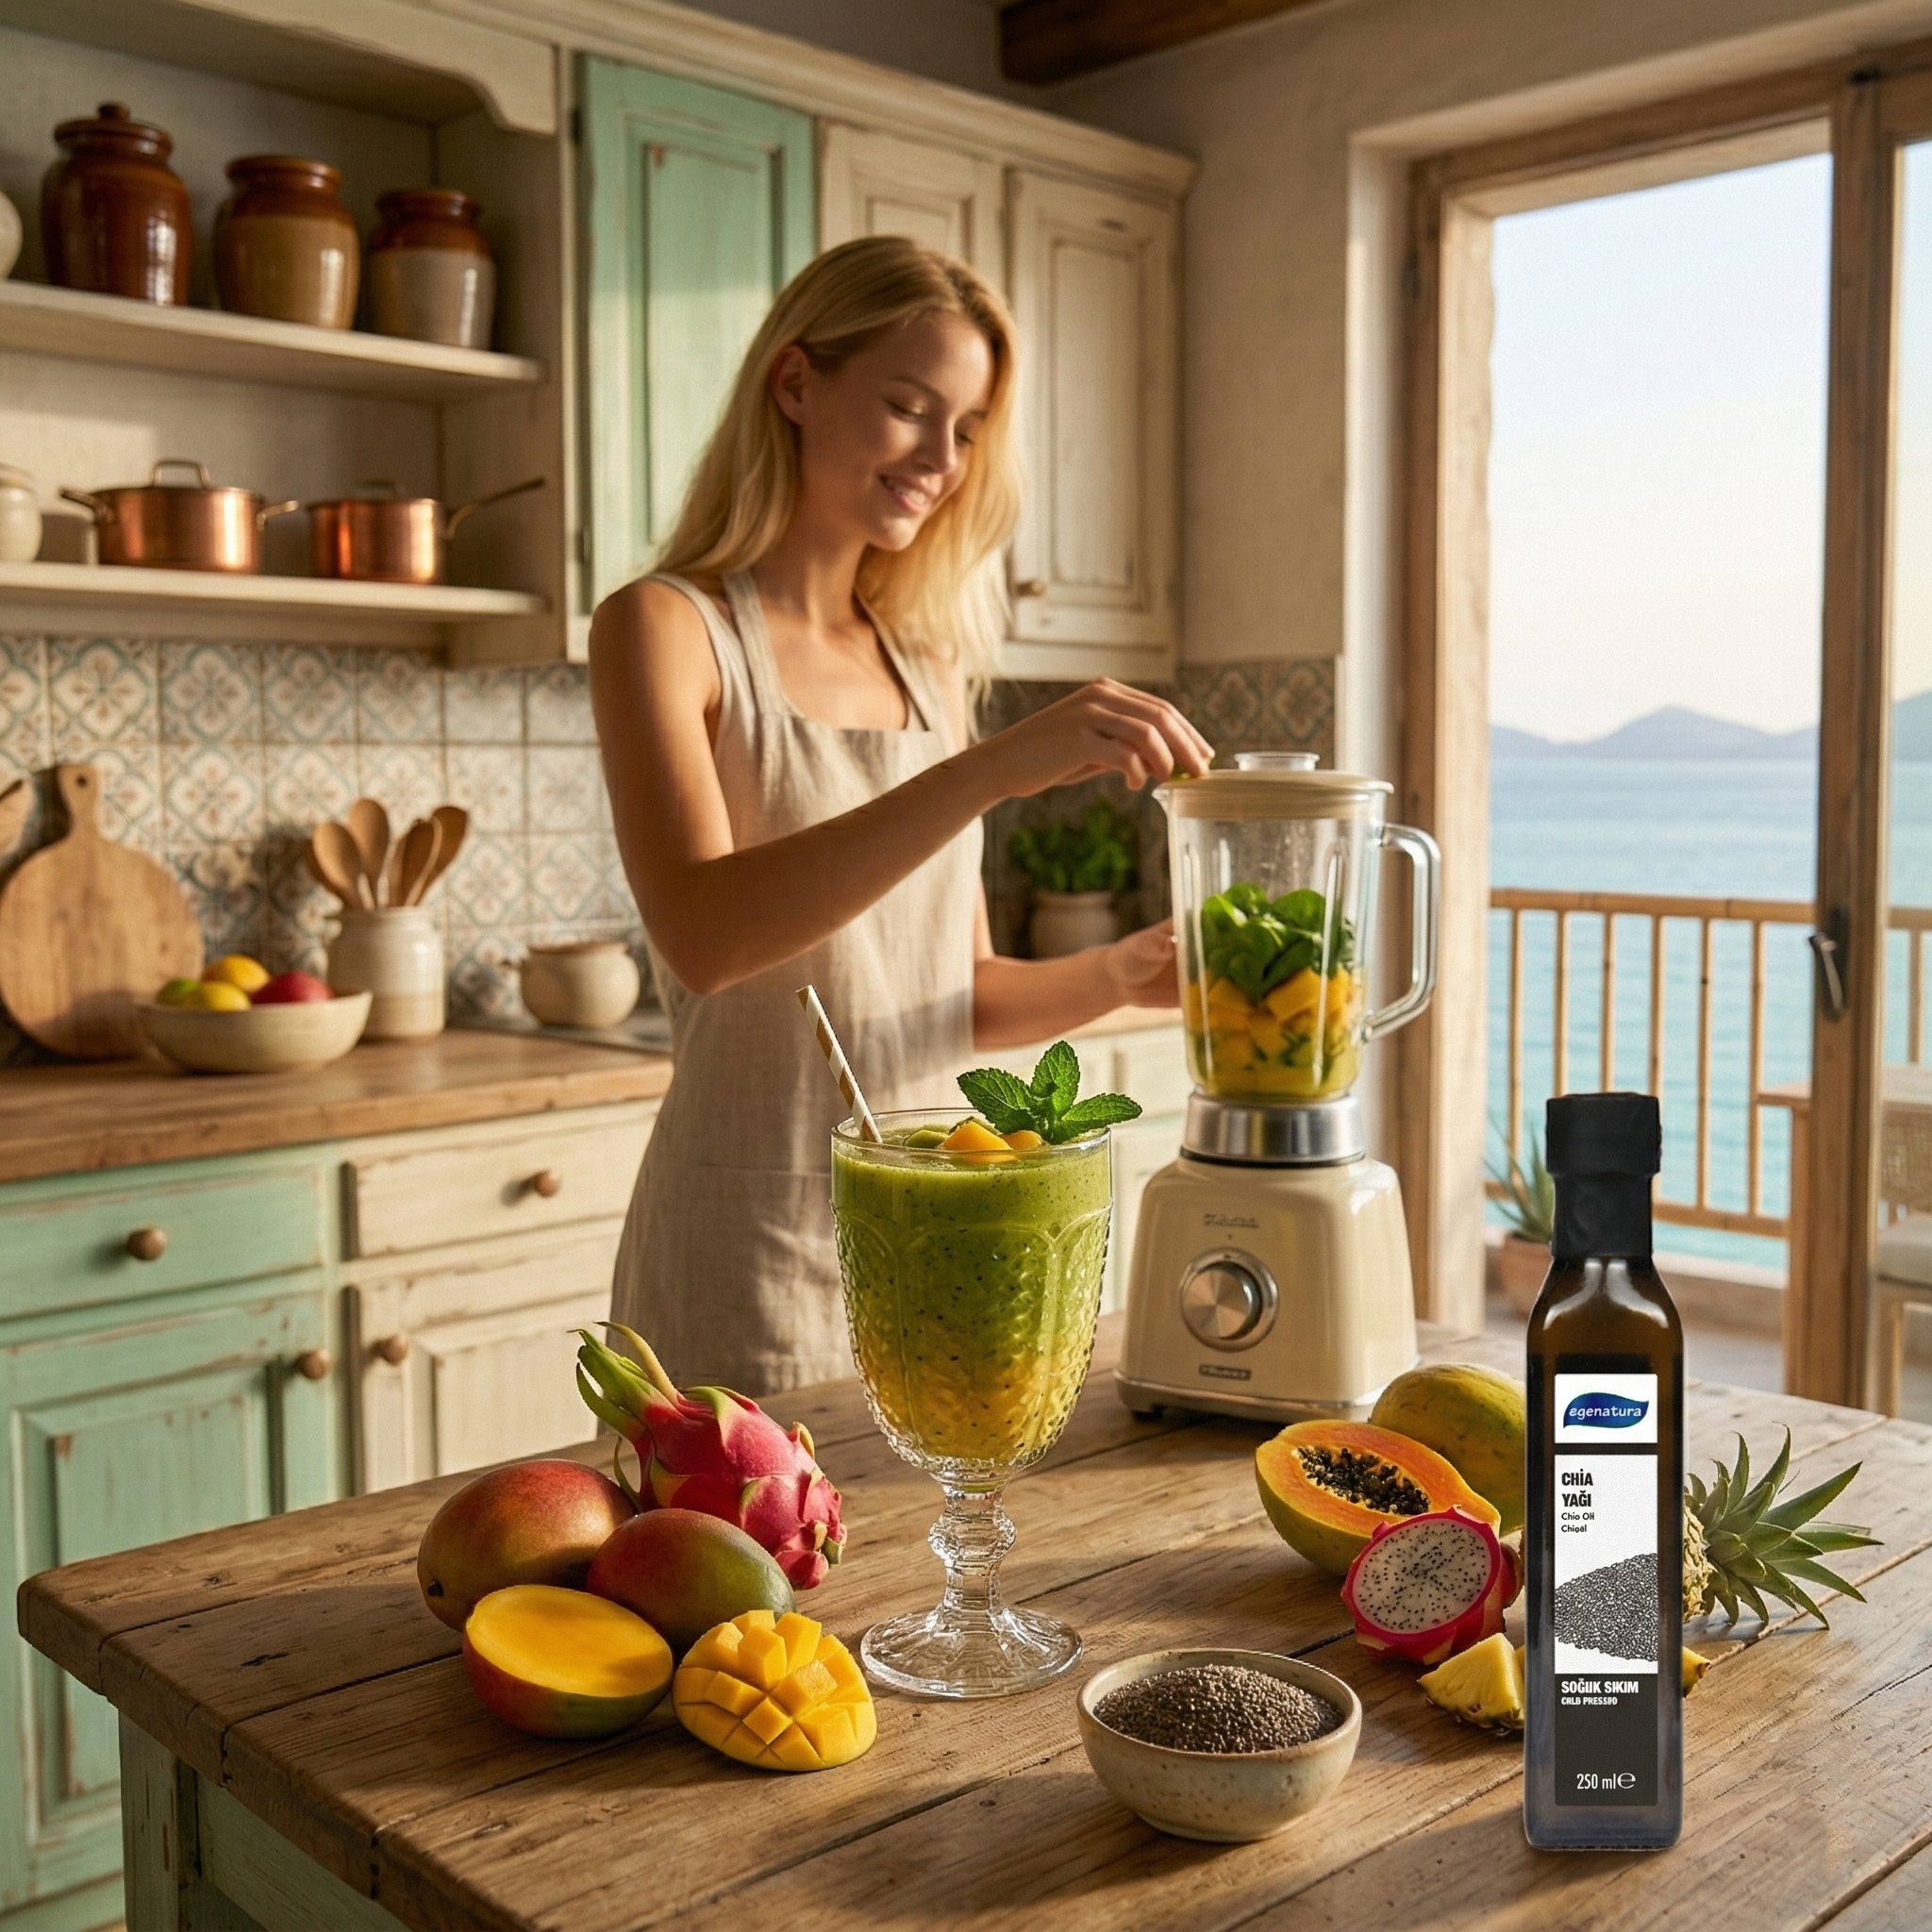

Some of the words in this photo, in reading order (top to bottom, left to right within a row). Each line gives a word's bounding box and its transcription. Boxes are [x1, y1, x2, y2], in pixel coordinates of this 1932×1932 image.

[1569, 1406, 1641, 1421] egenatura
[1561, 1468, 1594, 1486] CHİA
[1561, 1490, 1591, 1507] YAĞI
[1576, 1773, 1598, 1790] 250
